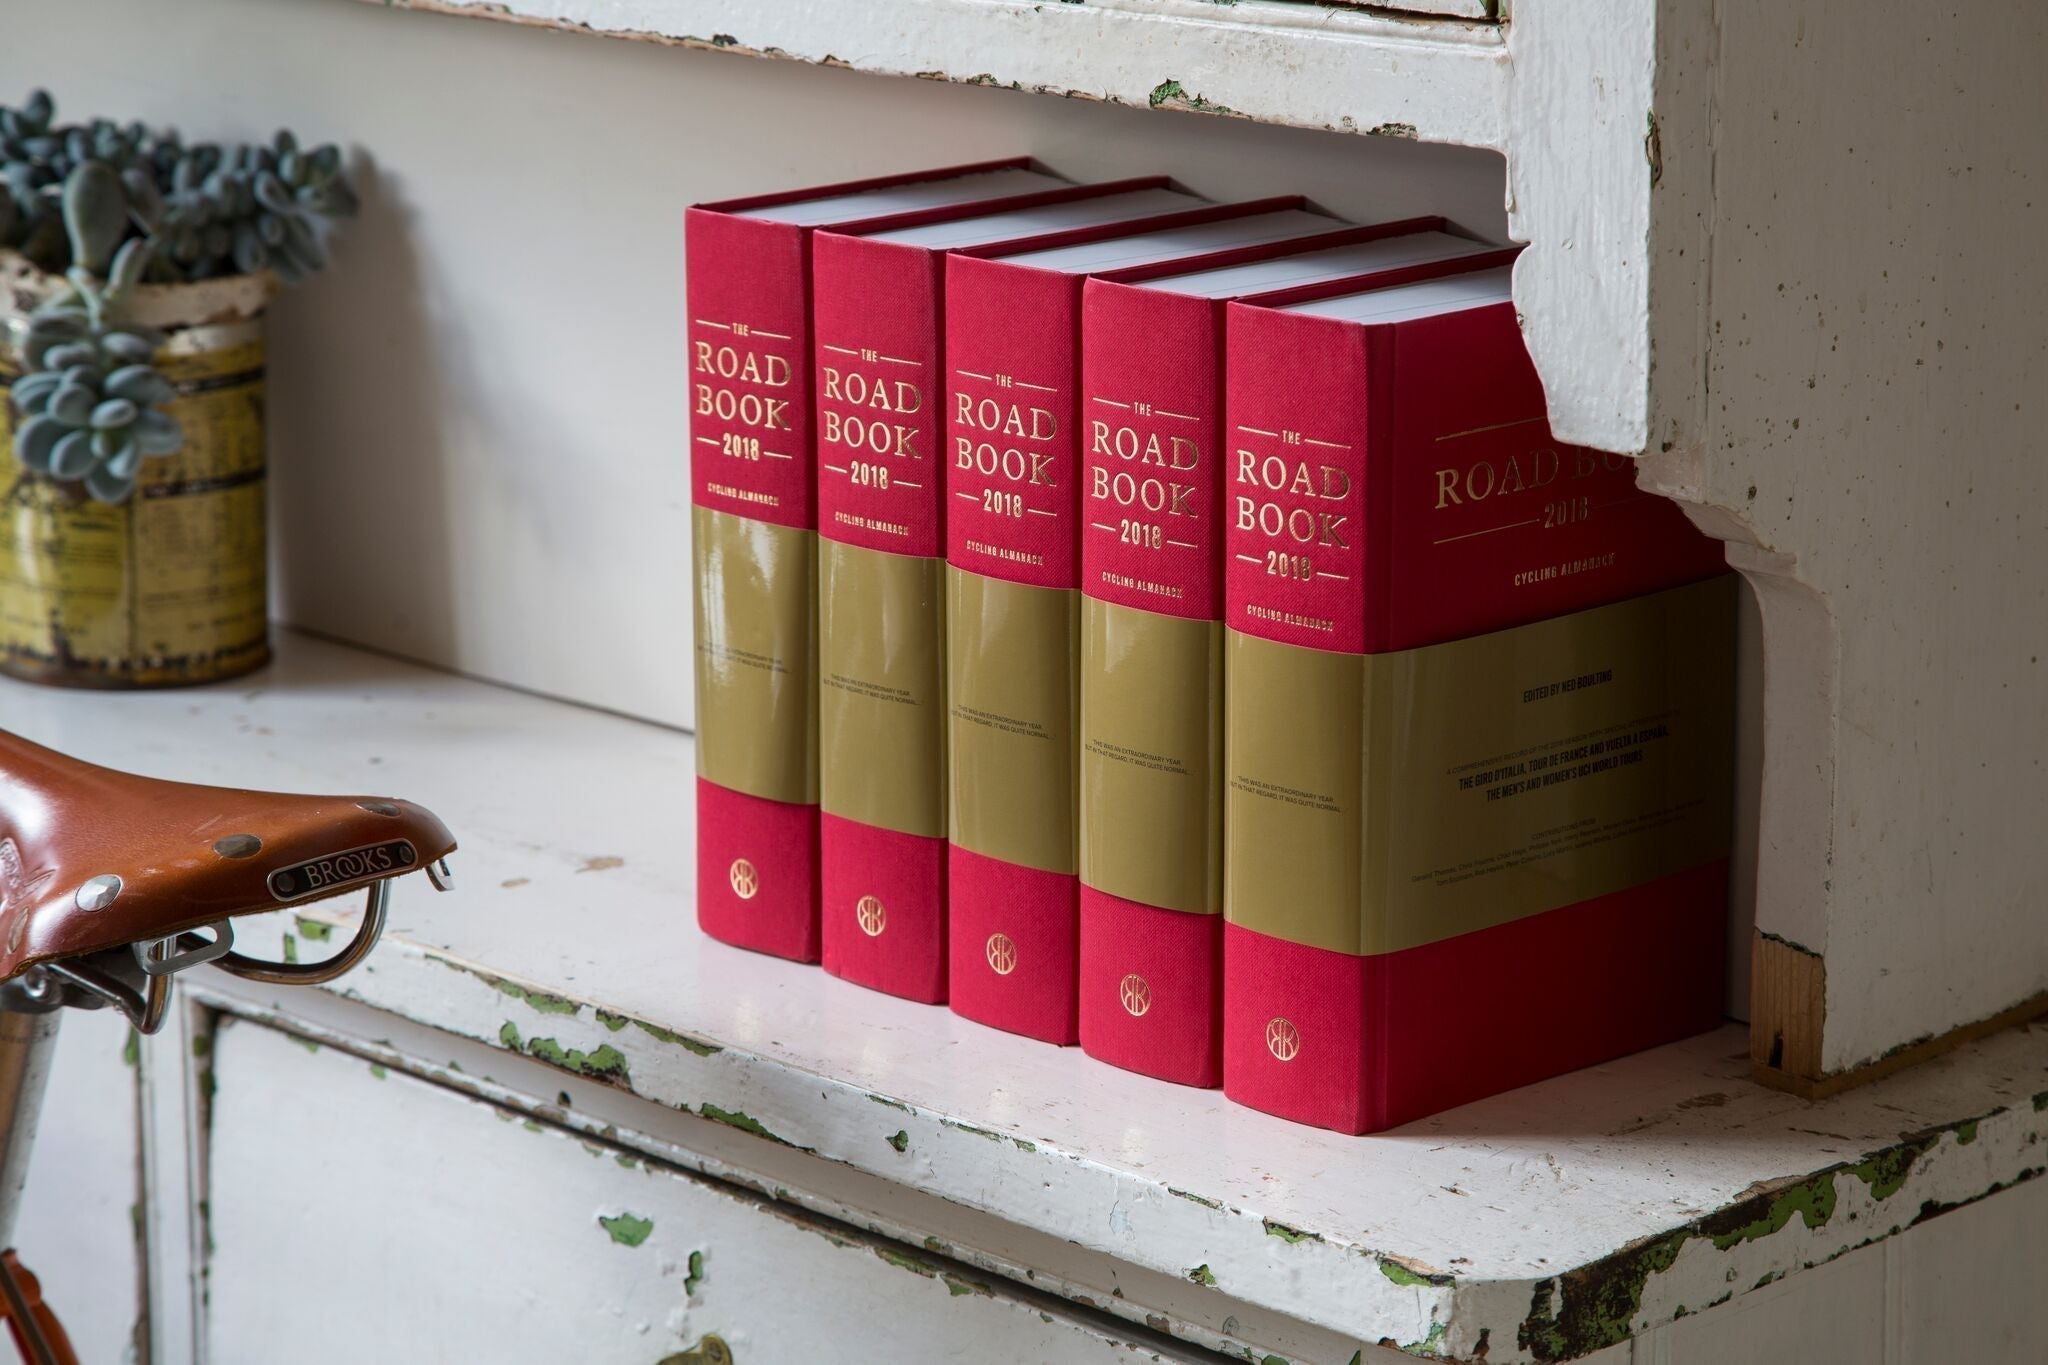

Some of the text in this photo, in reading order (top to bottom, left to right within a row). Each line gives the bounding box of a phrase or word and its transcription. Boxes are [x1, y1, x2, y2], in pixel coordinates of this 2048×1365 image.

[732, 322, 749, 337] THE
[695, 341, 792, 387] ROAD
[861, 348, 878, 363] THE
[823, 367, 922, 414] ROAD
[995, 373, 1012, 389] THE
[696, 384, 792, 431] BOOK
[955, 392, 1057, 441] ROAD
[1134, 401, 1151, 417] THE
[722, 432, 760, 461] 2018
[824, 410, 922, 459] BOOK
[1091, 420, 1199, 471] ROAD
[1282, 430, 1300, 445] THE
[850, 460, 889, 490] 2018
[956, 437, 1057, 488] BOOK
[1236, 449, 1351, 500] ROAD
[707, 482, 780, 507] CYCLING ALMANACK
[1091, 466, 1198, 519] BOOK
[1435, 448, 1559, 510] ROAD
[983, 488, 1022, 518] 2018
[1544, 497, 1589, 529] 2018
[835, 511, 909, 536] CYCLING ALMANACK
[1121, 519, 1161, 549] 2018
[1236, 496, 1350, 549] BOOK
[966, 539, 1043, 566] CYCLING ALMANACK
[1267, 550, 1312, 582] 2018
[1102, 571, 1183, 599] CYCLING ALMANACK
[1514, 552, 1615, 586] CYCLING ALMANACK
[1247, 604, 1281, 621] CYCLING
[1523, 668, 1612, 704] EDITED BY NED BOULTING
[1458, 775, 1474, 791] THE
[1474, 771, 1493, 787] GIRO
[1528, 756, 1548, 773] TOUR
[1549, 753, 1559, 767] DE
[1560, 745, 1589, 763] FRANCE
[1589, 741, 1605, 756] AND
[1605, 734, 1632, 752] VUELTA
[1486, 748, 1644, 803] THE MEN'S AND WOMEN'S UCI WORLD TOURS
[1271, 784, 1317, 799] EXTRAORDINARY
[304, 847, 391, 888] BROOKS
